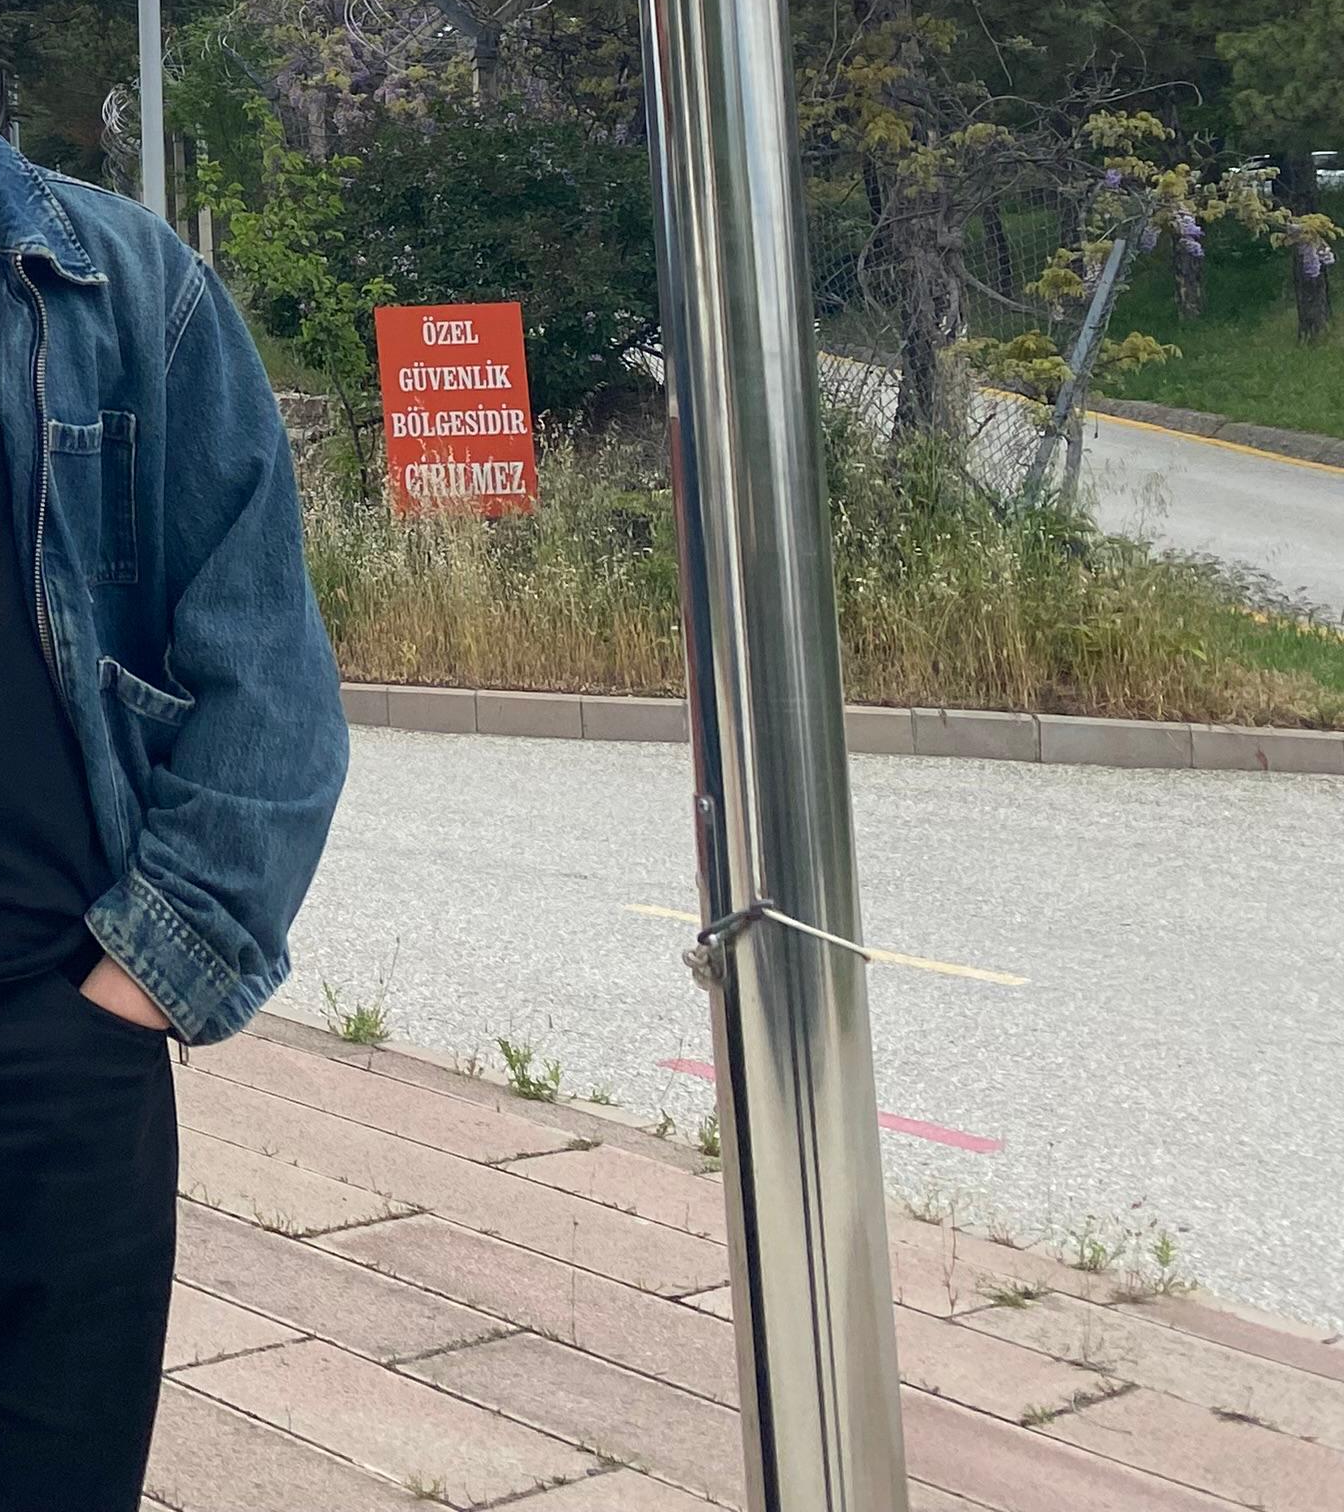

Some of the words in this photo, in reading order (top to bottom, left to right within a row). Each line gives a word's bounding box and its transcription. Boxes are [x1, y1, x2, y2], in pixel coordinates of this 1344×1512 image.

[422, 316, 479, 346] ÖZEL
[399, 359, 512, 392] GÜVENLİK
[392, 404, 528, 438] BÖLGESİDİR
